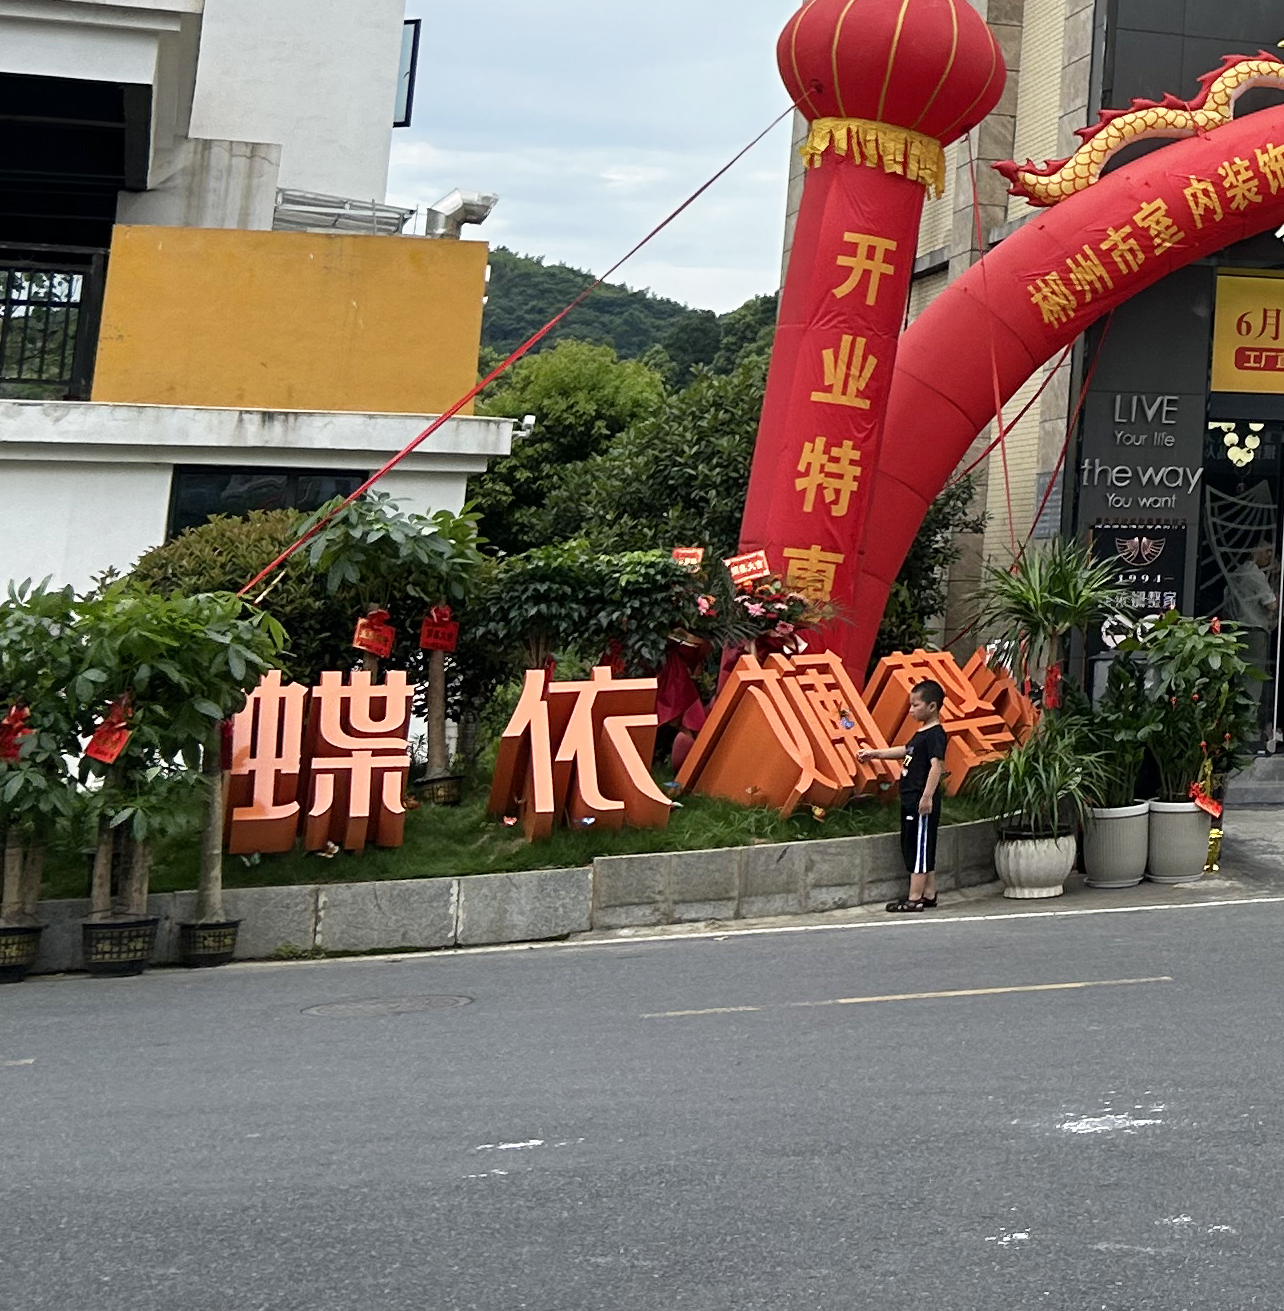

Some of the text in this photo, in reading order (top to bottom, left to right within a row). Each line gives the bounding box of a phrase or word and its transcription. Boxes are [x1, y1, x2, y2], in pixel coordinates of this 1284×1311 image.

[1114, 393, 1180, 425] LIVE
[1114, 430, 1176, 447] Your life
[1081, 458, 1204, 495] the way
[1106, 492, 1177, 509] You want
